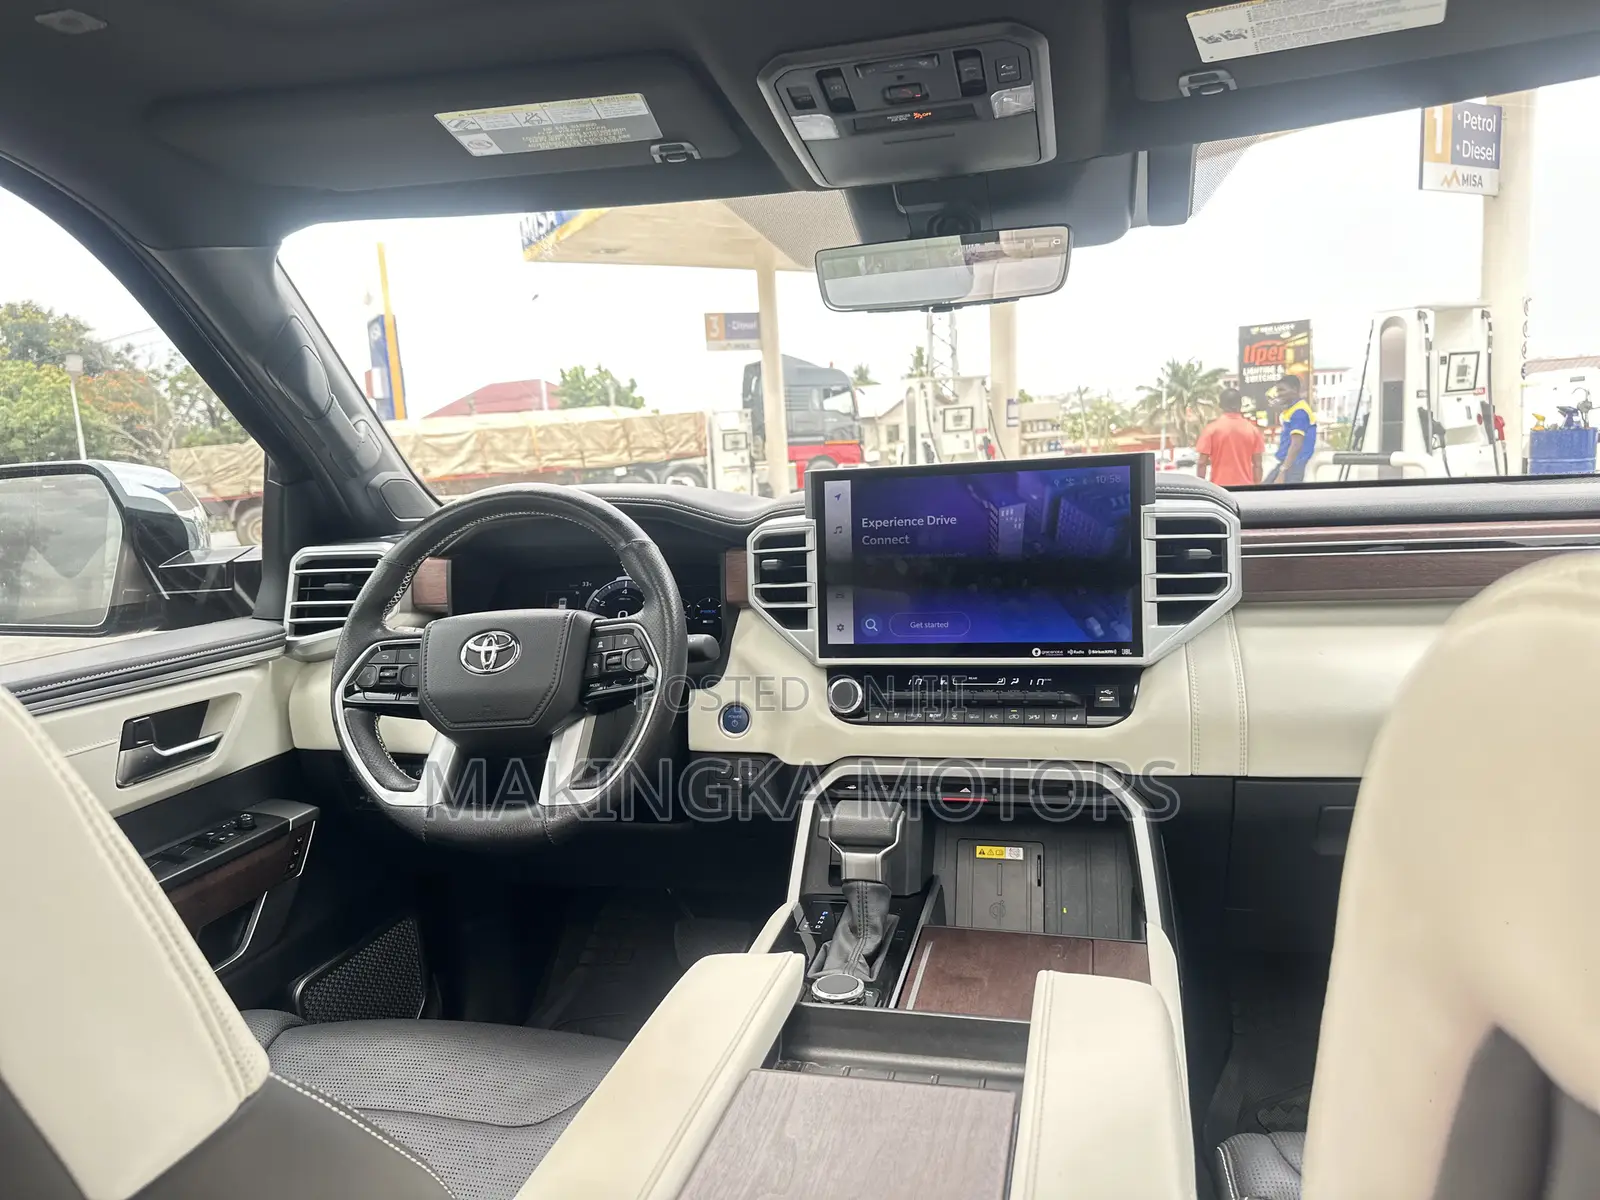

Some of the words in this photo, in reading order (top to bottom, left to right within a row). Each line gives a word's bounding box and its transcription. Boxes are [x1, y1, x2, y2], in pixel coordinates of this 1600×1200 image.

[1463, 111, 1496, 132] Petrol
[1462, 140, 1495, 161] Diesel
[1461, 174, 1483, 188] MISA
[709, 315, 720, 338] 3
[861, 516, 925, 530] Experience
[927, 515, 957, 527] Drive
[861, 534, 910, 546] Connect
[909, 621, 923, 629] Get
[924, 621, 949, 629] started
